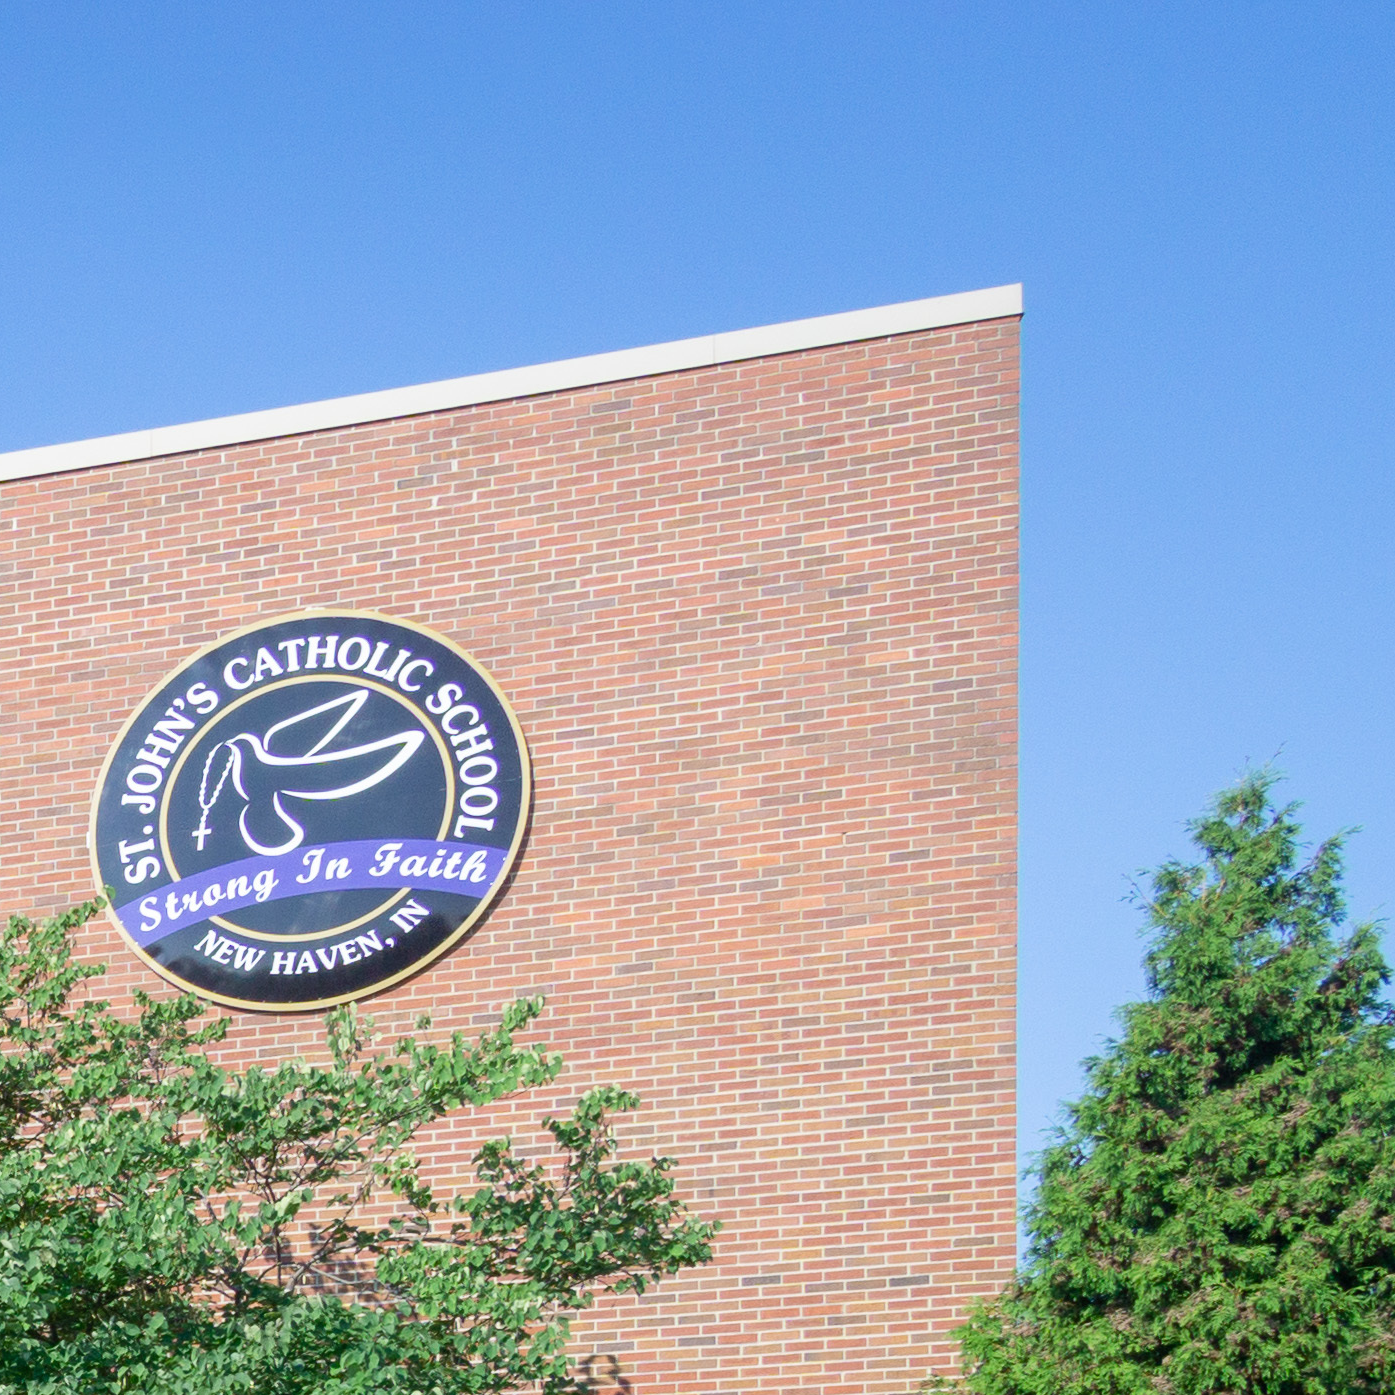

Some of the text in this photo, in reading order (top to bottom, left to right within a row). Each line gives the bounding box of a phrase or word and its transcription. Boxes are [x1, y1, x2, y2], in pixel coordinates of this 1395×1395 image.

[118, 635, 499, 884] ST. JOHN'S CATHOLIC SCHOOL
[139, 842, 487, 932] Strong In Faith
[194, 898, 431, 976] NEW HAVEN, IN
